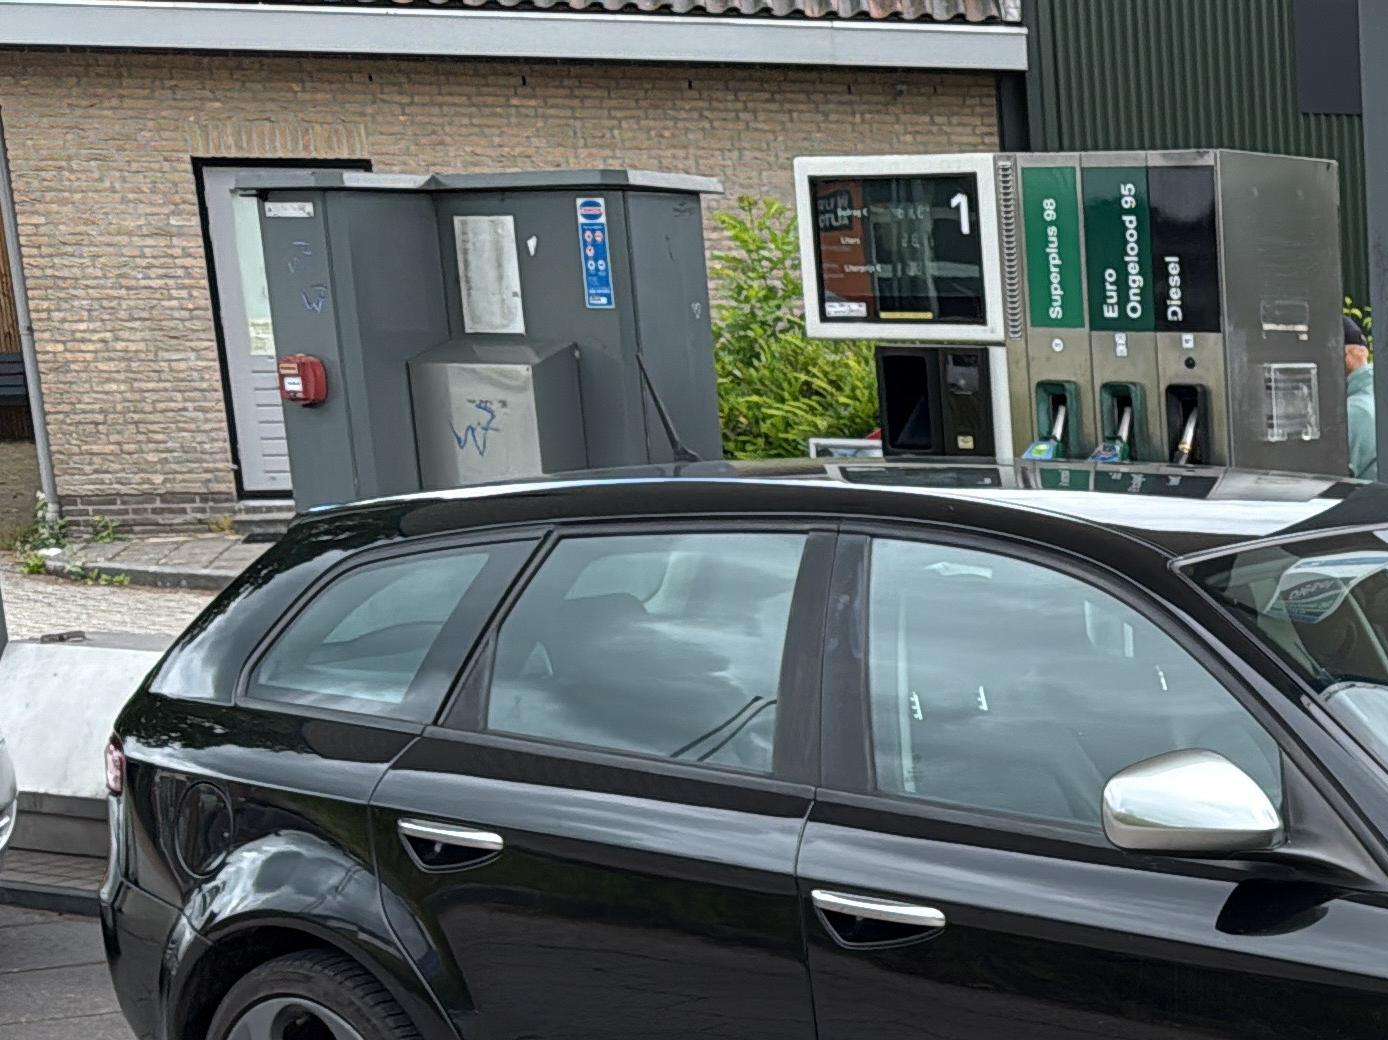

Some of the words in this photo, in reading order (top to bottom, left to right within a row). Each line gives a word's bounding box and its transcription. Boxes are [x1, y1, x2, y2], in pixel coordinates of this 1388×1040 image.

[950, 192, 970, 235] 1
[1043, 198, 1057, 221] 98
[1120, 183, 1136, 209] 95
[1046, 226, 1064, 319] Superplus
[1122, 215, 1144, 319] Ongelood
[1164, 256, 1183, 321] Diesel
[1103, 268, 1119, 318] Euro
